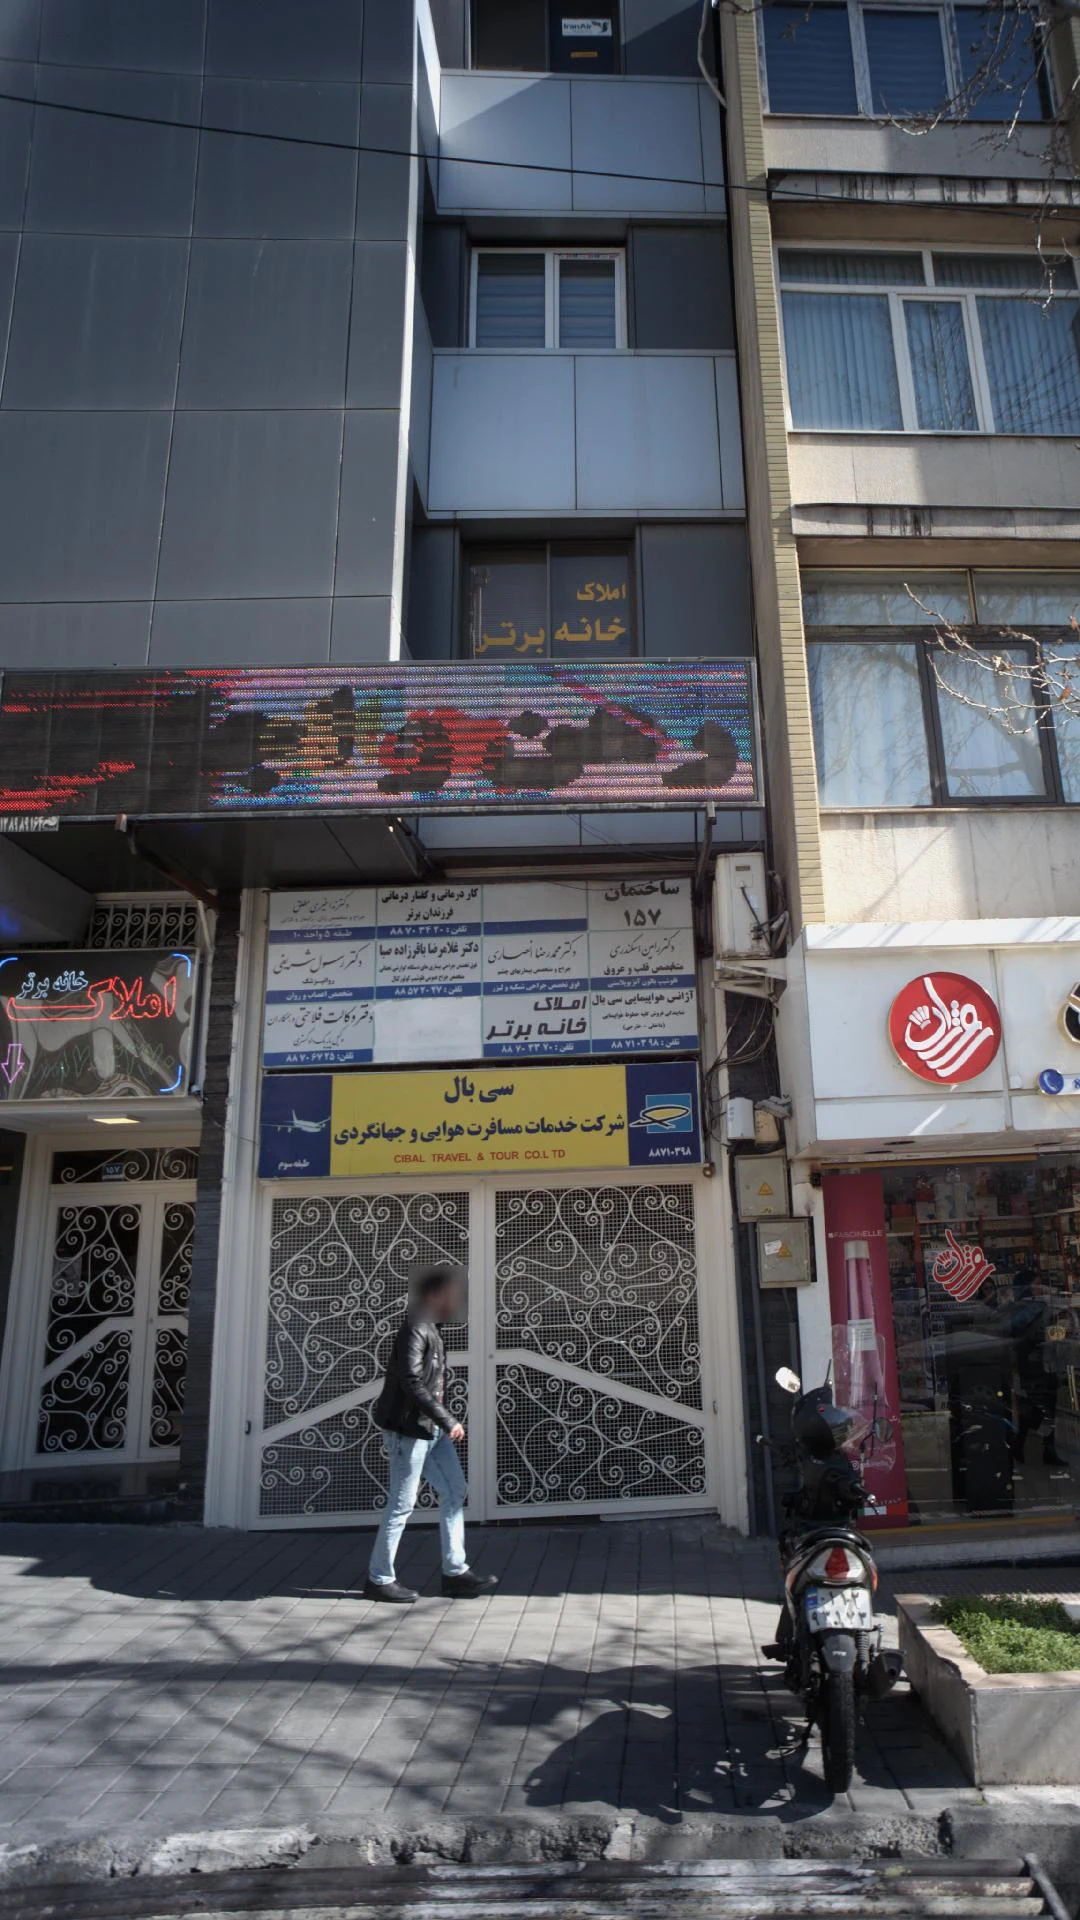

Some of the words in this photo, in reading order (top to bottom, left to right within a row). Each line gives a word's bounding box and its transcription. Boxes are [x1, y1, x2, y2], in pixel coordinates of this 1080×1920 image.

[576, 581, 627, 602] املاک
[554, 616, 626, 642] خانه
[475, 622, 545, 654] برتر
[381, 890, 409, 903] درمانی
[437, 889, 464, 901] درمانی
[466, 888, 479, 901] کار
[604, 880, 680, 901] ساختمان
[406, 908, 421, 921] برتر
[423, 906, 454, 920] فرزندان
[623, 908, 662, 927] ۱۵۷
[303, 930, 322, 939] واحد
[324, 930, 330, 938] ۵
[333, 929, 353, 937] طبقه
[428, 941, 459, 958] غلامرضا
[460, 941, 479, 957] دکتر
[560, 934, 583, 960] دکتر
[658, 930, 680, 956] دکتر
[344, 942, 371, 971] دکتر
[379, 944, 393, 959] صبا
[488, 940, 534, 964] انصاری
[603, 966, 625, 976] عروق
[627, 967, 632, 975] و
[634, 962, 650, 972] قلب
[652, 962, 684, 974] متخصص
[16, 972, 50, 1000] برتر
[53, 970, 88, 992] خانه
[526, 982, 547, 991] جراحی
[547, 982, 568, 990] تخصص
[7, 976, 177, 1021] املاک
[286, 992, 302, 1001] روان
[308, 990, 328, 999] اعصاب
[328, 991, 353, 999] متخصص
[592, 994, 606, 1006] بال
[607, 995, 622, 1006] سی
[624, 992, 665, 1005] هواپیمایی
[667, 989, 694, 1003] آژانس
[533, 996, 587, 1011] املاک
[323, 1006, 357, 1024] وکالت
[352, 1003, 373, 1027] دفتر
[486, 1020, 533, 1041] برتر
[538, 1018, 587, 1036] خانه
[444, 1075, 475, 1104] بال
[479, 1083, 515, 1103] سی
[420, 1121, 465, 1142] هوایی
[467, 1117, 523, 1141] مسافرت
[525, 1116, 578, 1134] خدمات
[580, 1113, 625, 1136] شرکت
[334, 1121, 406, 1145] جهانگردی
[409, 1128, 418, 1143] و
[394, 1154, 425, 1164] CIBAL
[432, 1152, 471, 1162] TRAVEL
[477, 1152, 484, 1161] &
[490, 1151, 519, 1161] TOUR
[648, 1147, 692, 1157] ۸۸۷۱۰۳۹۸
[278, 1162, 293, 1170] سوم
[293, 1160, 310, 1169] طبقه
